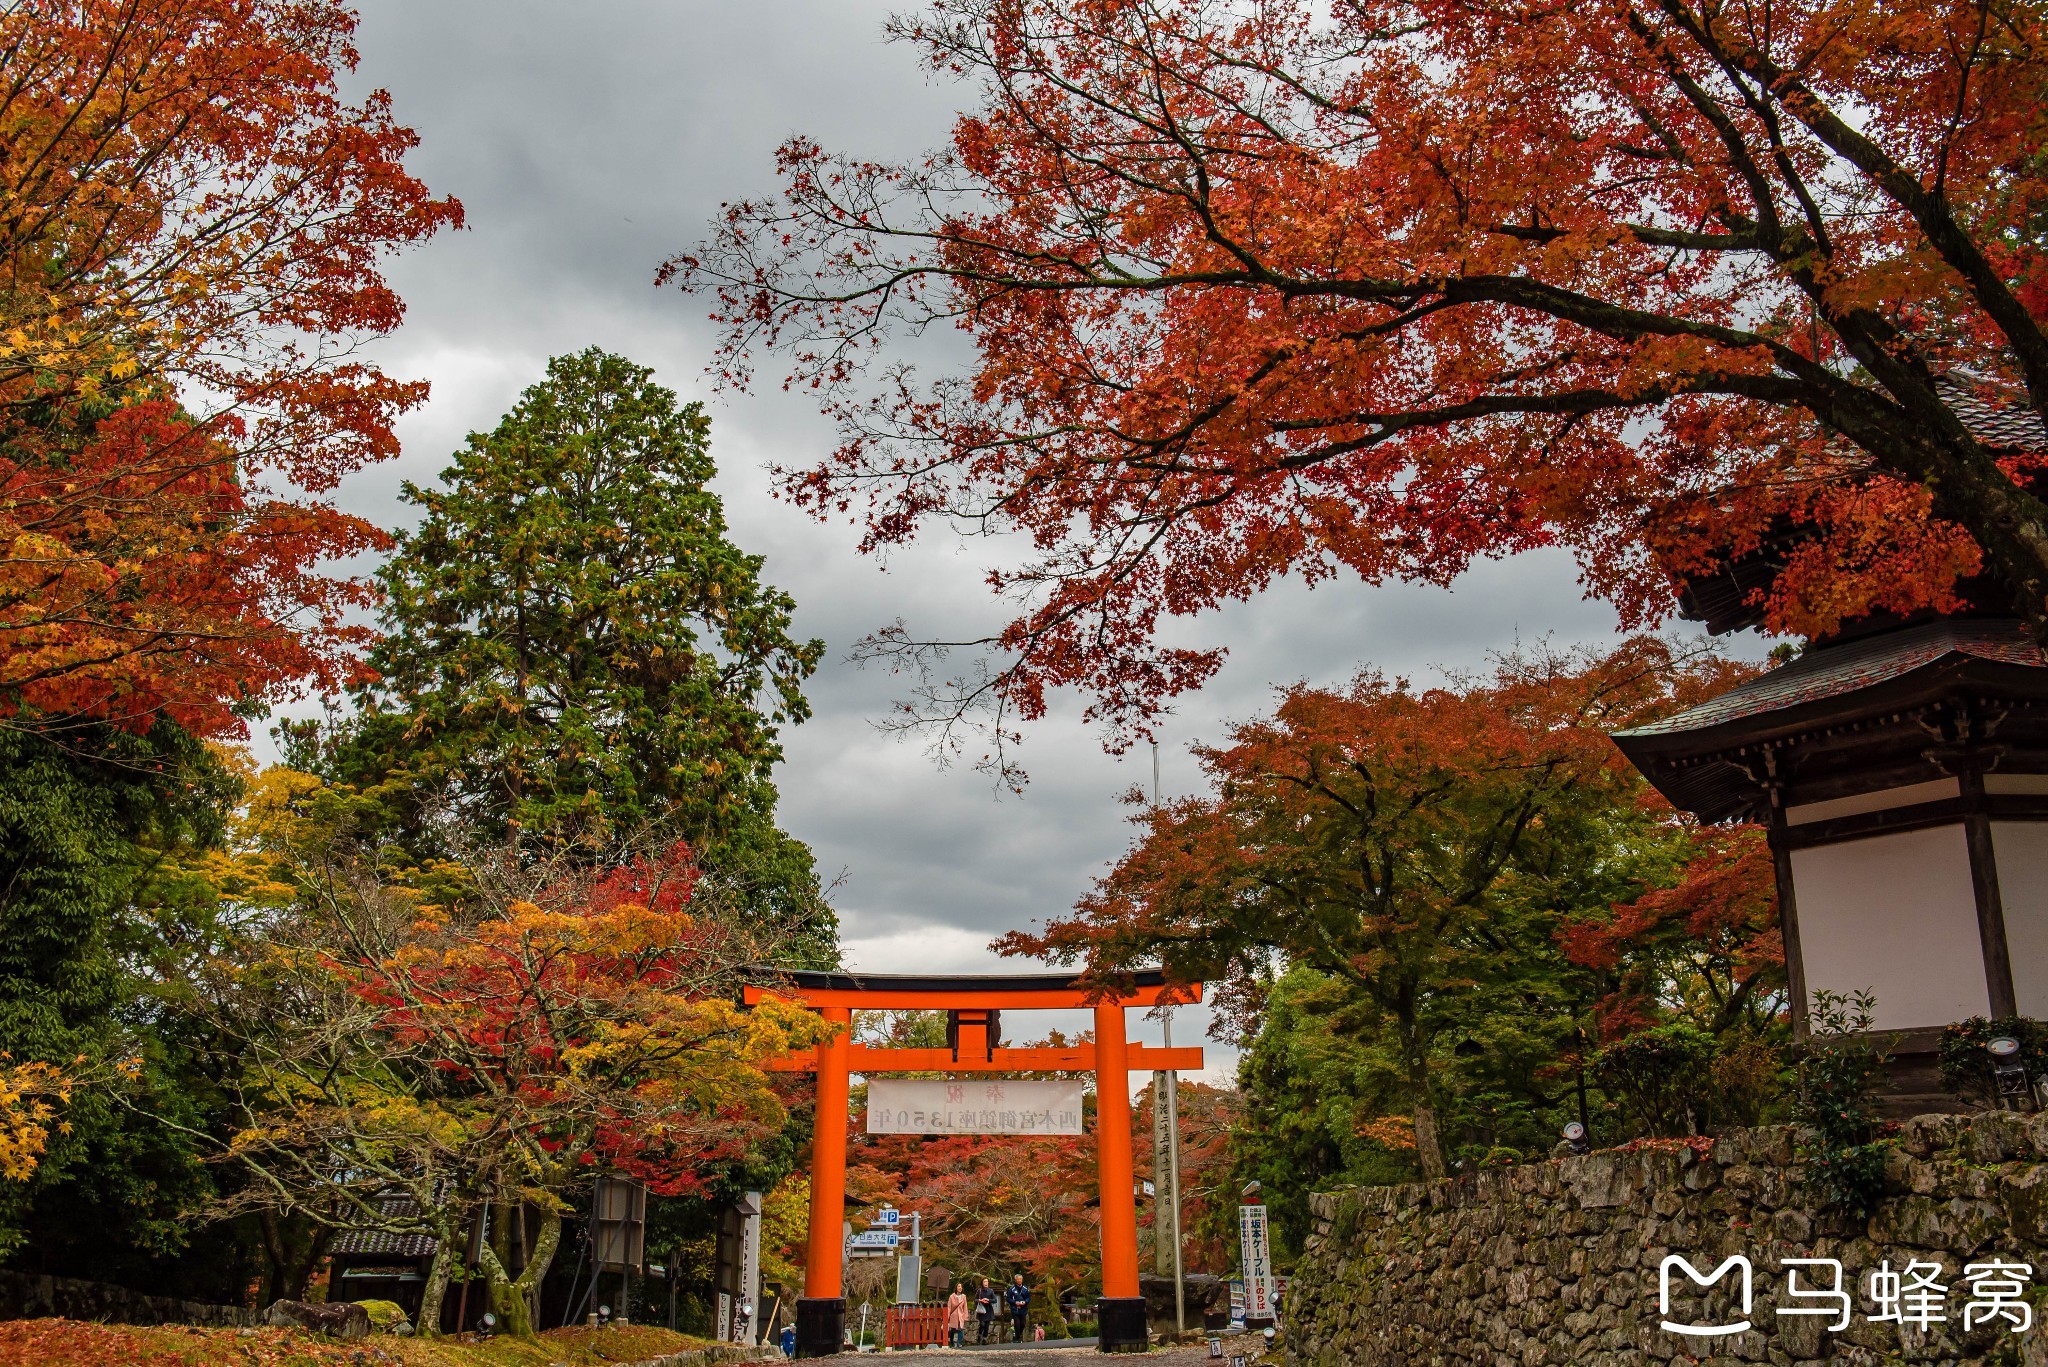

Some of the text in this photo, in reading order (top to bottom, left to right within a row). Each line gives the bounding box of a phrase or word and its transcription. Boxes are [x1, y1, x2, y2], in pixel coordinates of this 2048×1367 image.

[1251, 1219, 1264, 1277] 坂本ケーブル
[1256, 1287, 1265, 1310] のりば
